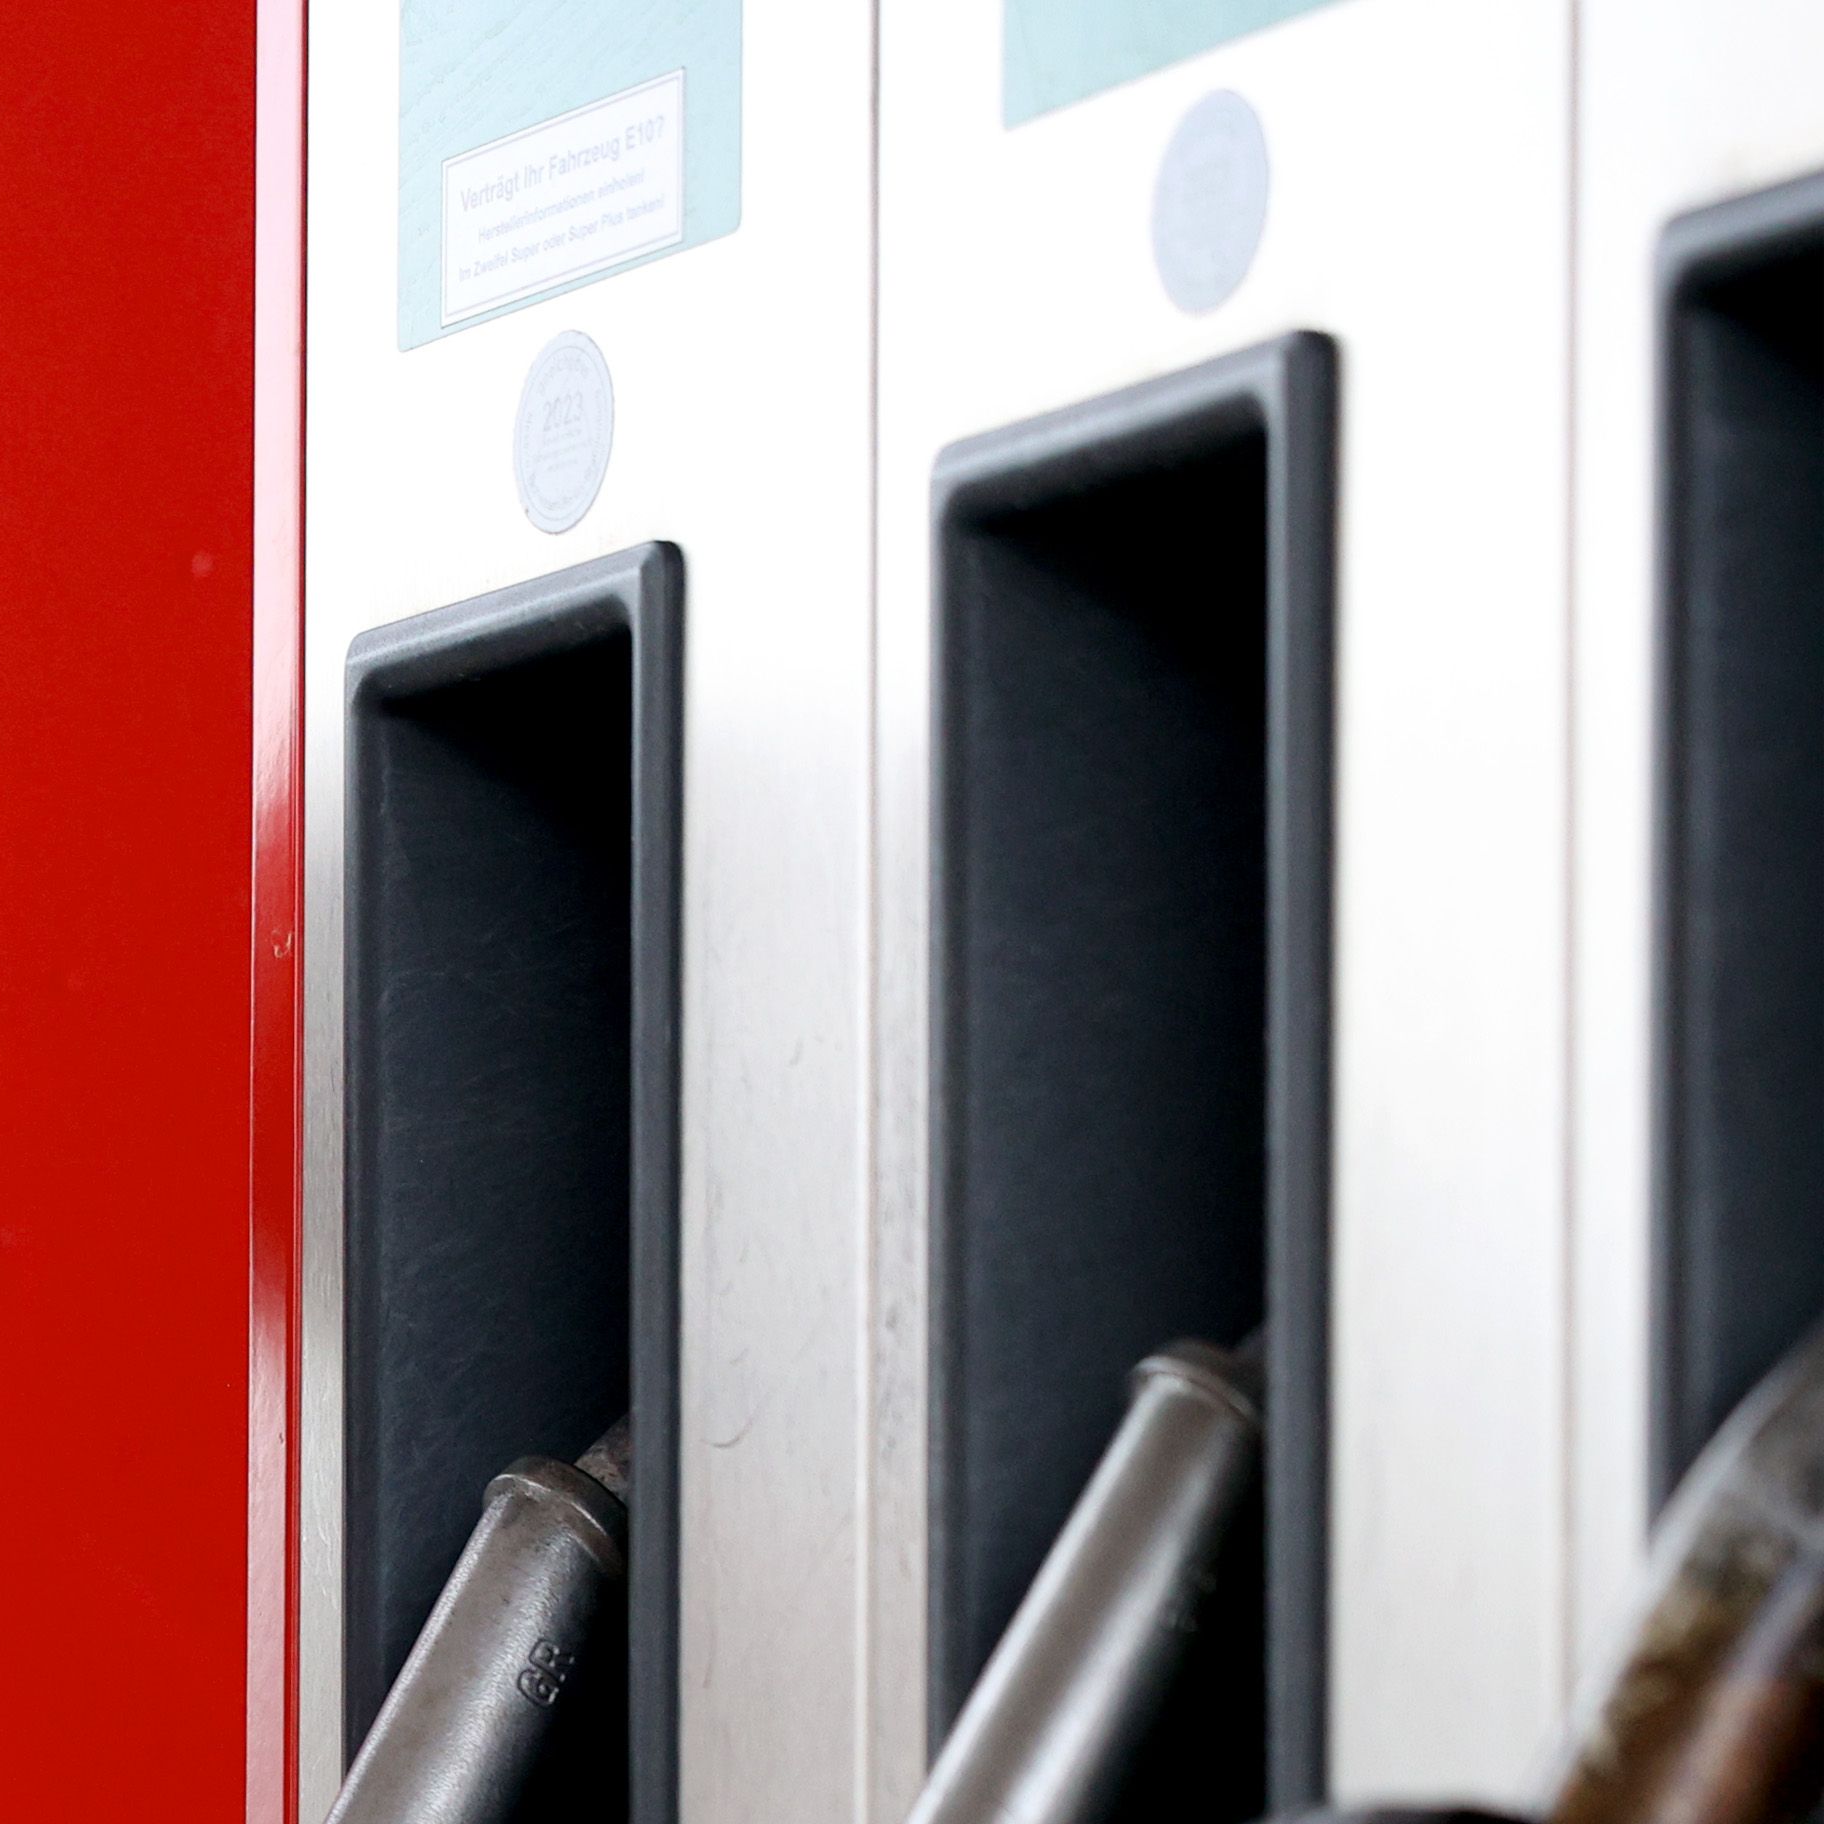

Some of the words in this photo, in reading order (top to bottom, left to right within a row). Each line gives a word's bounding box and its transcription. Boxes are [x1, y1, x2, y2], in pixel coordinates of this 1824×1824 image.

[460, 172, 520, 212] Verträgt
[524, 164, 545, 188] Ihr
[549, 136, 620, 181] Fahrzeug
[625, 115, 665, 150] E10?
[473, 249, 509, 277] Zweifel
[511, 240, 541, 264] Super
[543, 232, 567, 252] oder
[568, 220, 599, 243] Super
[601, 210, 624, 230] Plus
[543, 389, 584, 432] 2023
